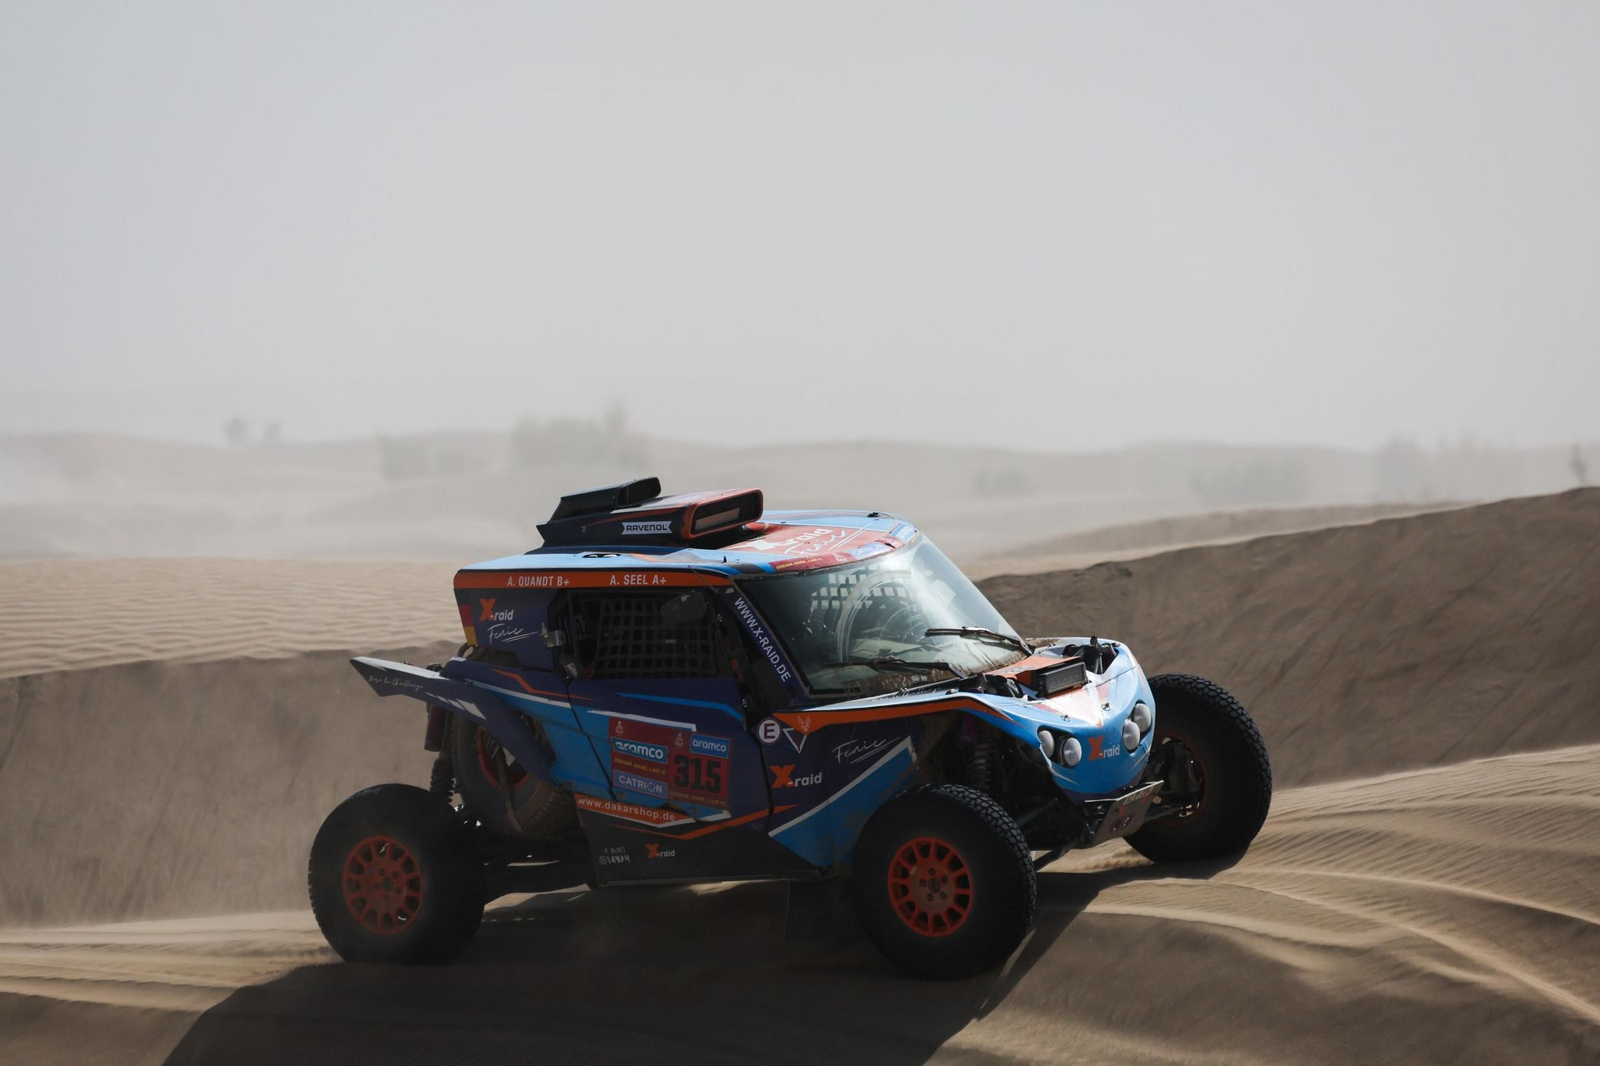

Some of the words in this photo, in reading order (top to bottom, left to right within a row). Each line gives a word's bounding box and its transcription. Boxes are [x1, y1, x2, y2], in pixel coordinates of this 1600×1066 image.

[625, 523, 669, 534] RAVENOL
[507, 576, 516, 587] A.
[518, 576, 554, 587] QUANDT
[556, 576, 570, 587] B+
[610, 574, 620, 586] A.
[623, 574, 648, 586] SEEL
[652, 574, 667, 585] A+
[479, 598, 514, 621] X-raid
[734, 597, 791, 683] WWW.X-RAID.DE
[764, 723, 775, 739] E
[614, 742, 664, 760] aramco
[692, 738, 727, 753] aramco
[1088, 735, 1120, 761] X-raid
[674, 754, 721, 794] 315
[769, 764, 822, 788] X-raid
[577, 797, 676, 822] www.dakarshop.de
